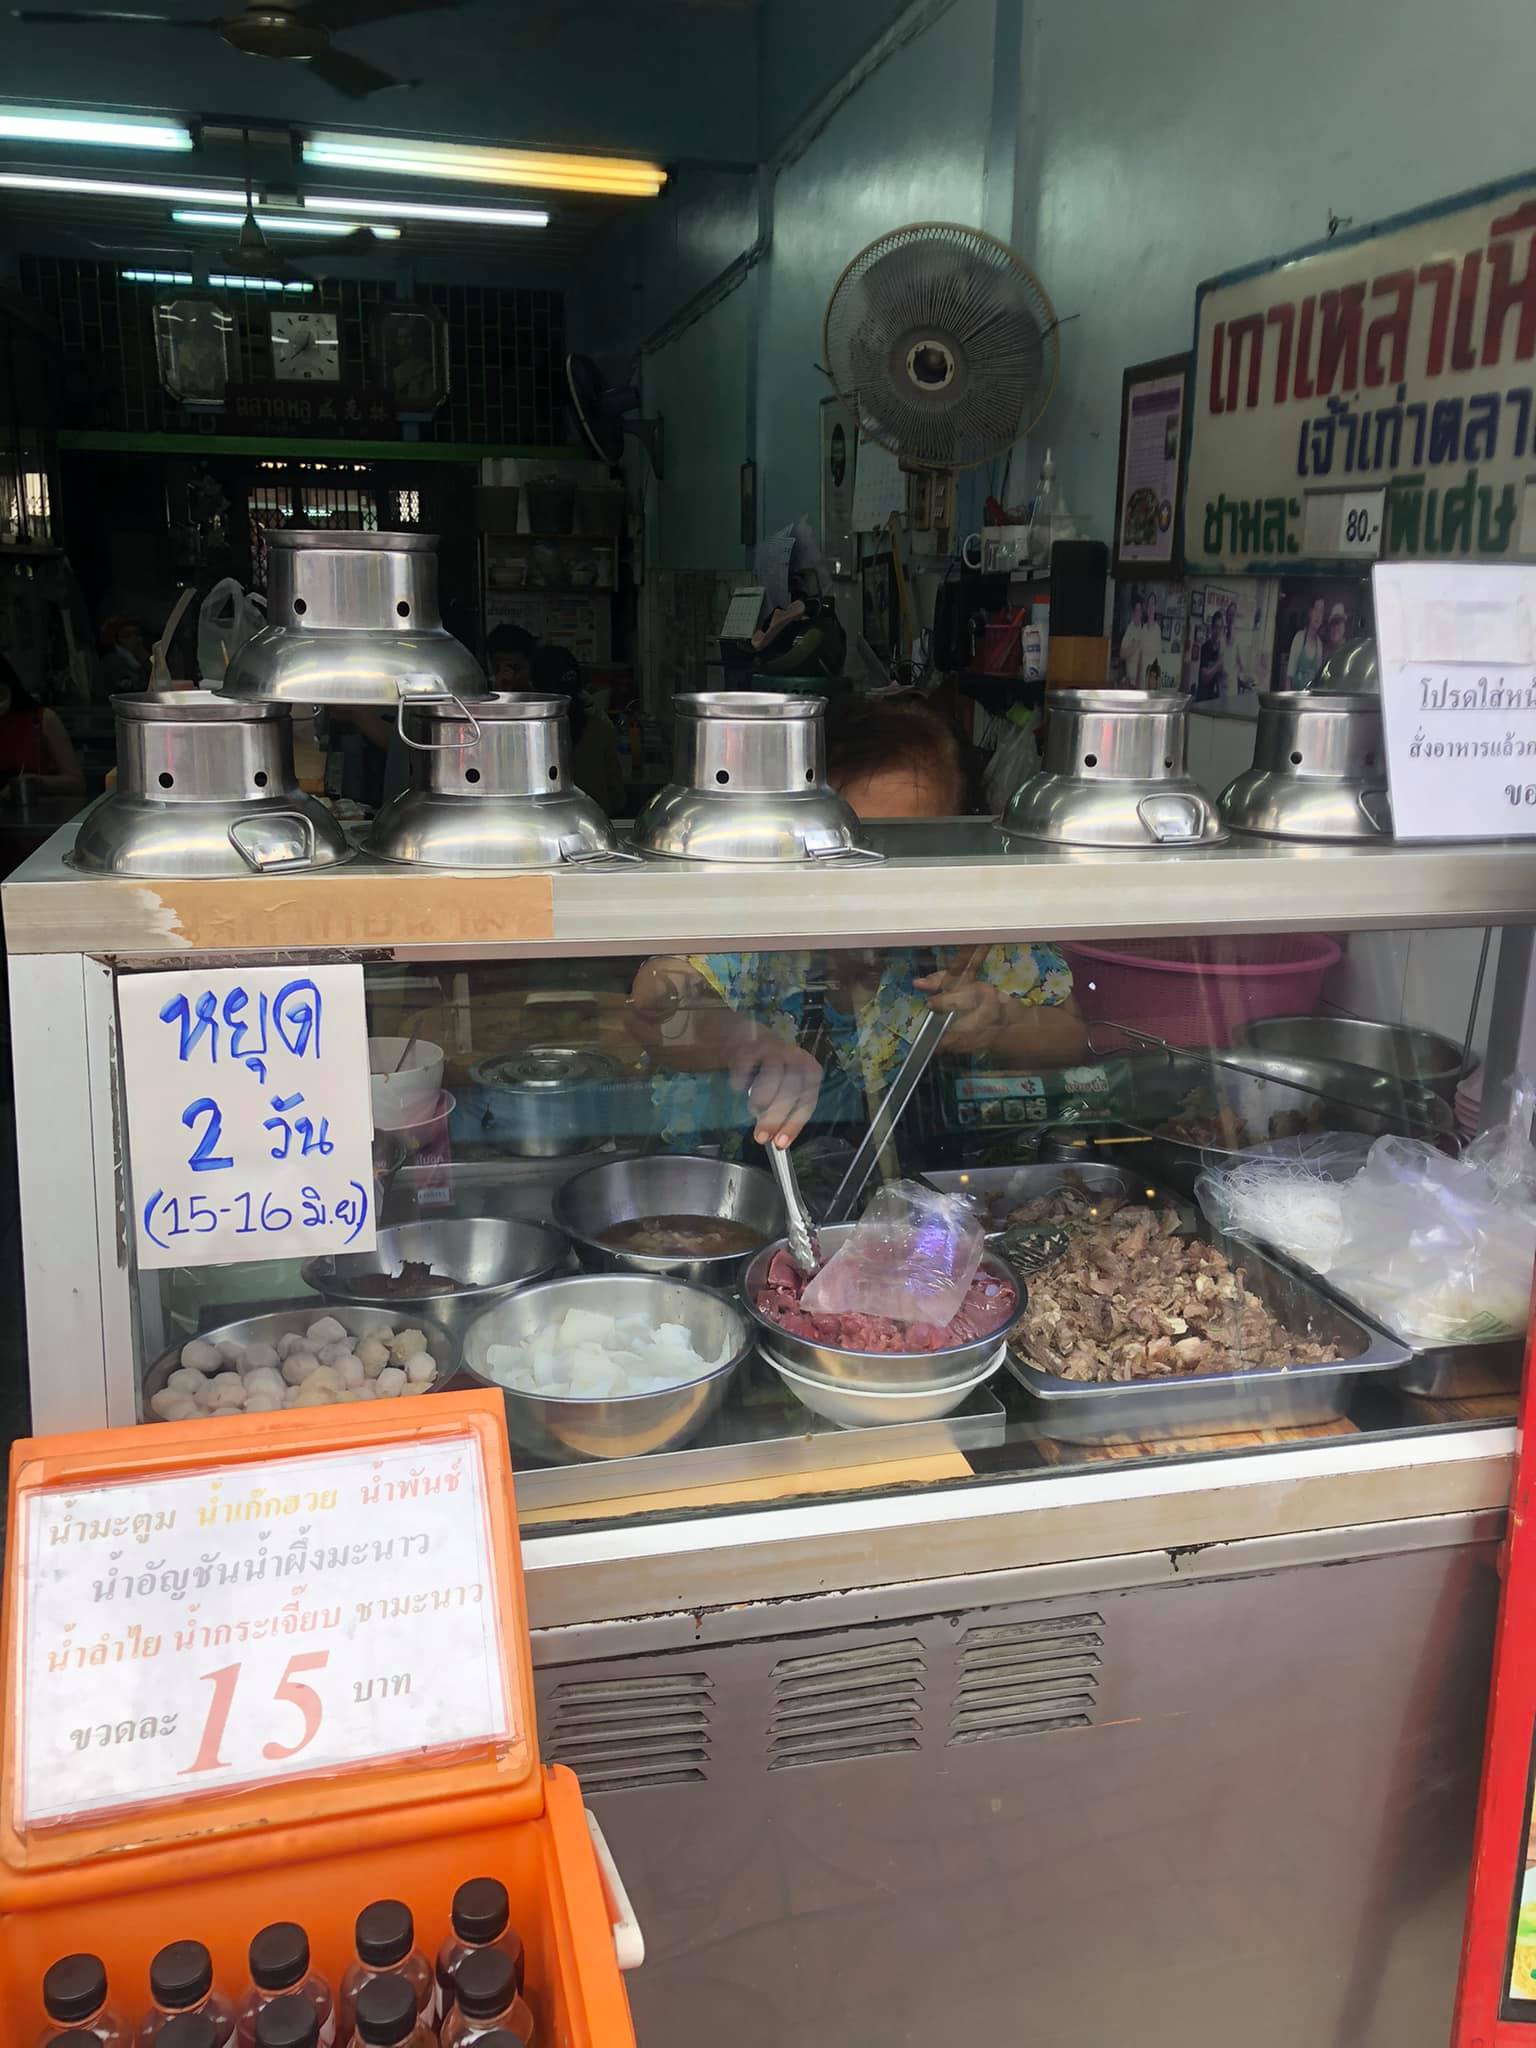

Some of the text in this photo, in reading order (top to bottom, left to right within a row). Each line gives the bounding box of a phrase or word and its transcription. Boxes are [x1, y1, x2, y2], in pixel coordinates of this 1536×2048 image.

[1297, 383, 1536, 477] เจ้าเก่าตลา
[1203, 492, 1300, 555] ชามละ
[1388, 468, 1518, 555] พิเศษ
[159, 978, 322, 1084] หยุด
[181, 1091, 334, 1172] 2 วัน
[50, 1498, 177, 1545] น้ำมะตูม
[360, 1458, 463, 1505] น้ำพันช์
[47, 1583, 484, 1672] น้ำลำไย น้ำกระเจี๊ยบ ชามะนาว
[70, 1649, 412, 1776] ขวดละ 15 บาท
